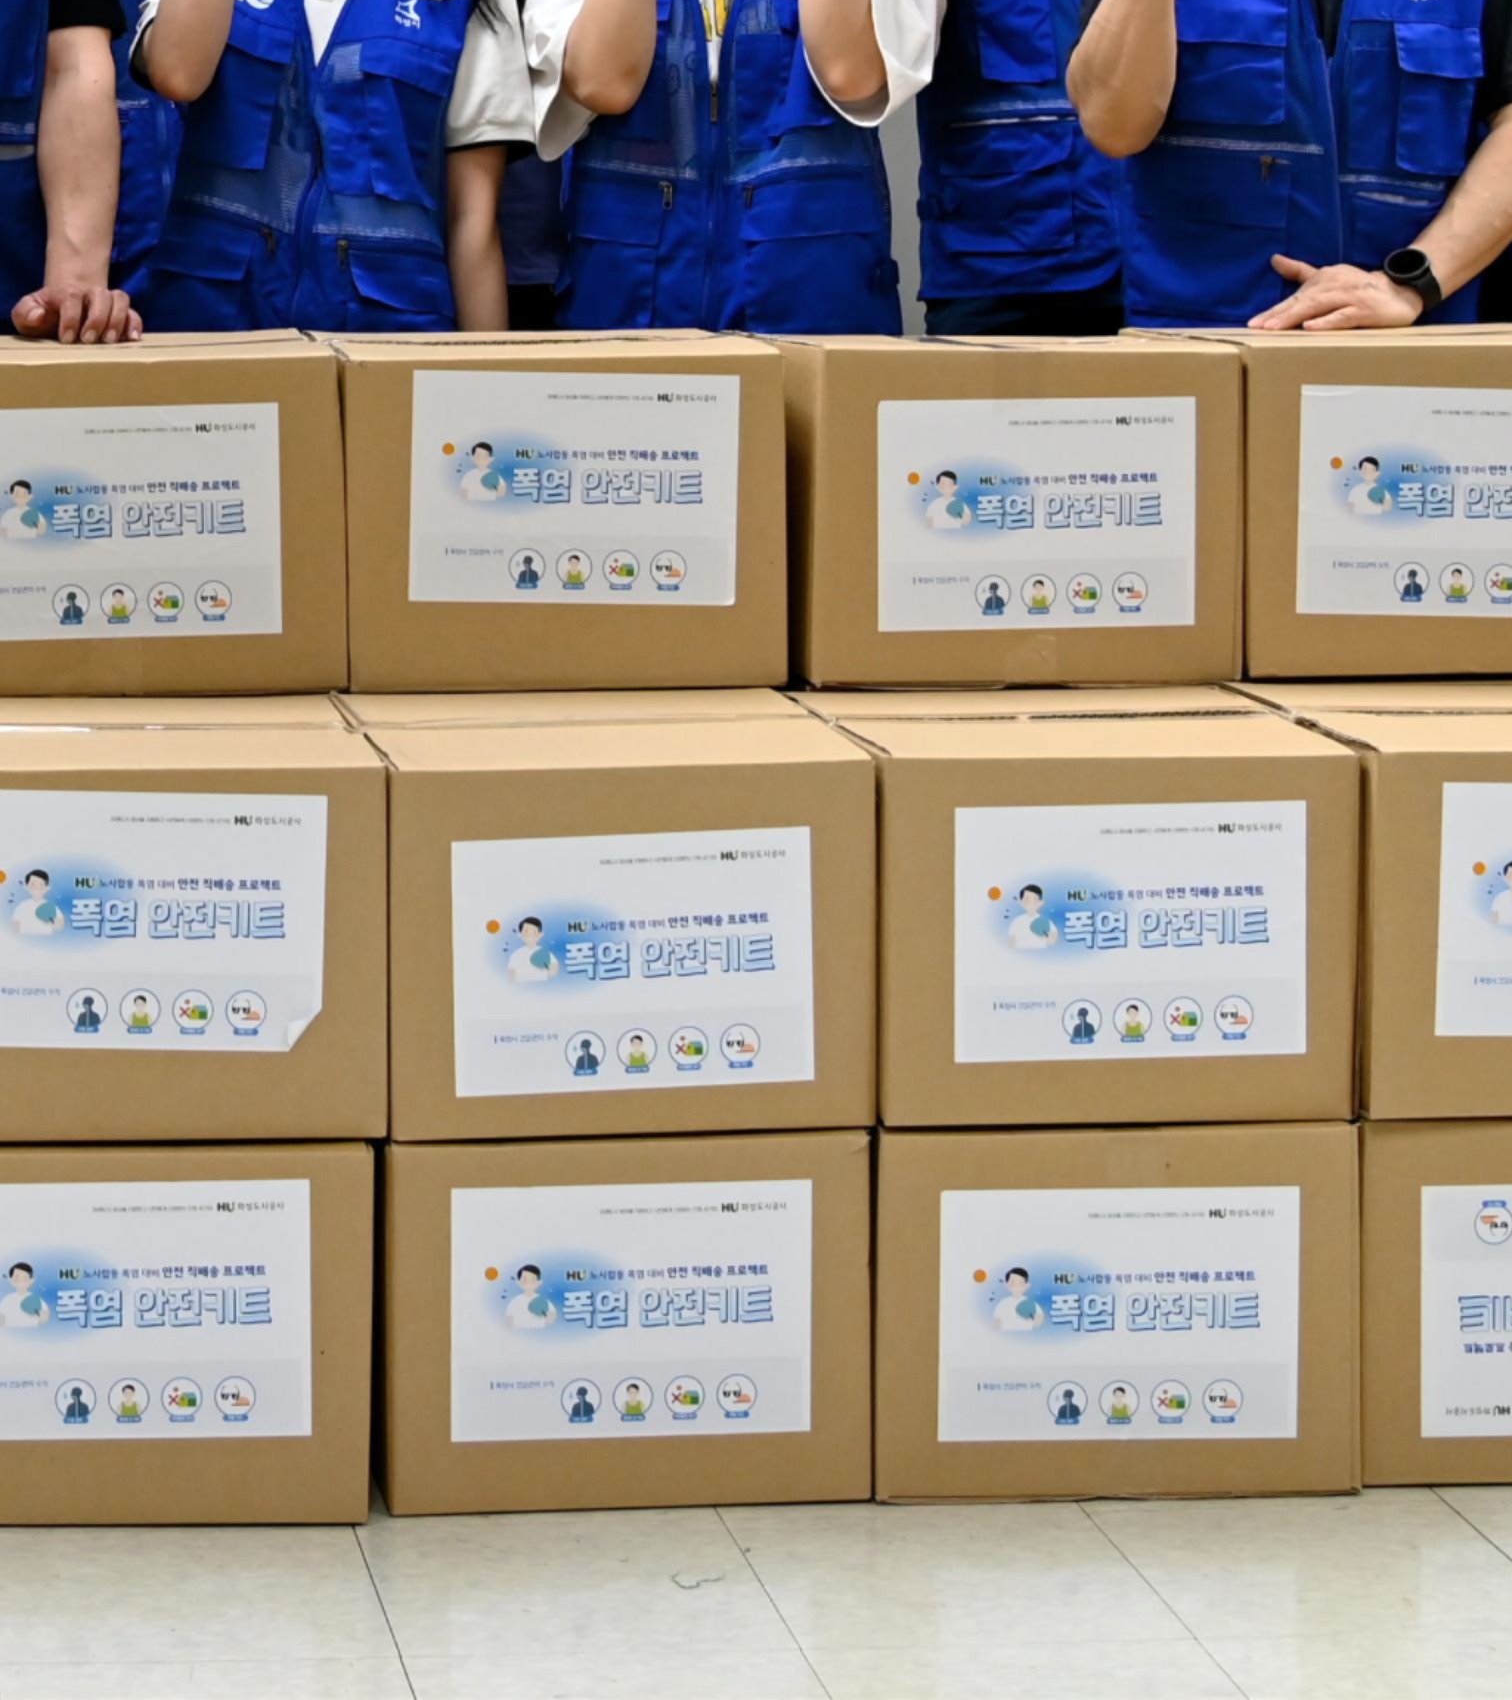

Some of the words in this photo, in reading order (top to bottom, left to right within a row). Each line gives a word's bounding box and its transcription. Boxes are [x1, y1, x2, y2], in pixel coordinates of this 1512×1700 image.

[1115, 415, 1132, 426] HU
[511, 467, 571, 504] 폭염
[580, 467, 703, 505] 안전키트
[978, 475, 997, 487] HU
[1067, 473, 1087, 485] 안전
[1089, 472, 1118, 485] 직배송
[1119, 471, 1159, 484] 프로젝트
[50, 501, 113, 541] 폭염
[120, 496, 246, 539] 안전키트
[975, 493, 1035, 531] 폭염
[1042, 488, 1163, 530] 안전키트
[1396, 481, 1454, 518] 폭염
[234, 814, 253, 826] HU
[719, 849, 739, 862] HU
[74, 877, 96, 889] HU
[177, 878, 199, 891] 안전
[202, 878, 235, 891] 직배송
[237, 879, 282, 892] 프로젝트
[70, 898, 137, 939] 폭염
[147, 898, 285, 939] 안전키트
[566, 920, 588, 934] HU
[667, 915, 689, 929] 안전
[691, 913, 724, 928] 직배송
[726, 911, 770, 926] 프로젝트
[1062, 908, 1128, 951] 폭염
[1137, 902, 1270, 949] 안전키트
[563, 938, 631, 983] 폭염
[639, 929, 775, 979] 안전키트
[54, 1287, 123, 1330] 폭염
[132, 1282, 272, 1329] 안전키트
[561, 1288, 629, 1331] 폭염
[638, 1281, 774, 1329] 안전키트
[1049, 1292, 1116, 1334] 폭염
[1125, 1288, 1261, 1332] 안전키트
